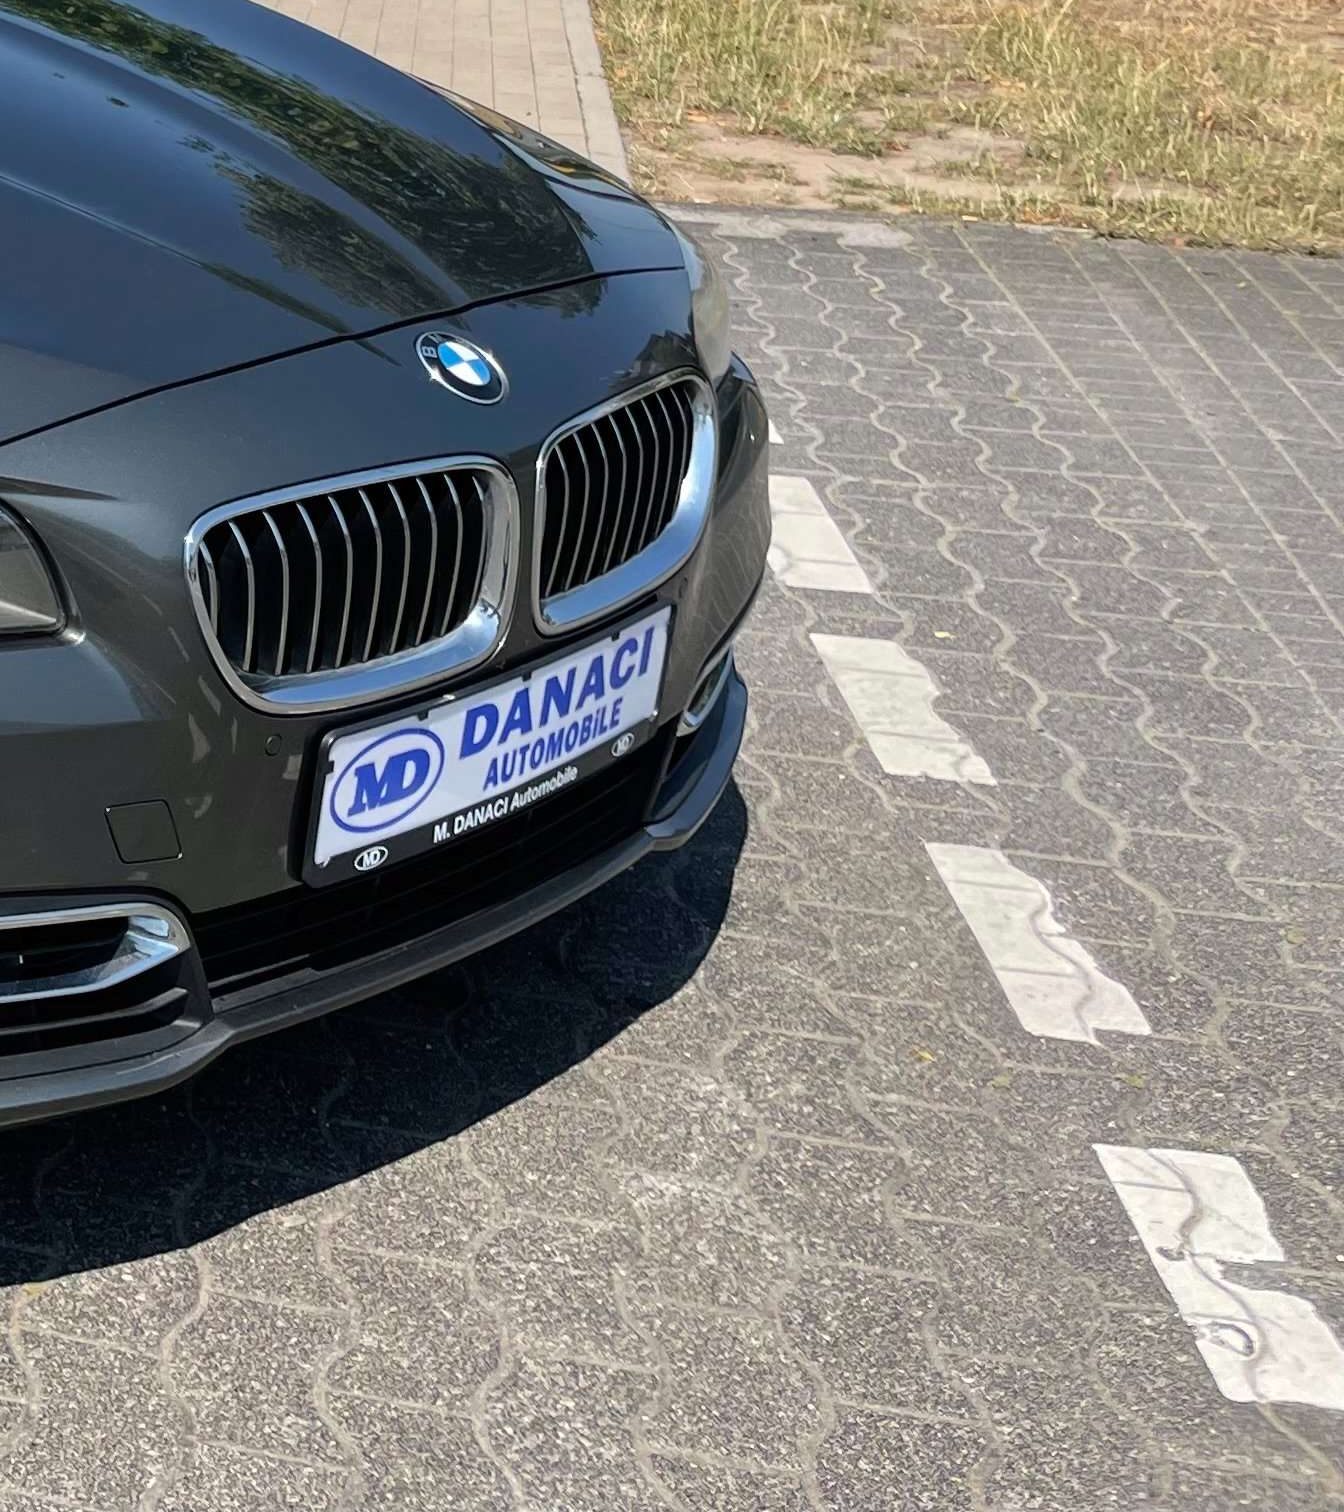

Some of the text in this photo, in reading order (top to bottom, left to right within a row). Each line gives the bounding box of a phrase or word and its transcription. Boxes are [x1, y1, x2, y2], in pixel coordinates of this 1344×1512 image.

[458, 626, 655, 760] DANACI
[347, 748, 431, 818] MD
[433, 766, 579, 844] M. DANACI Automobile
